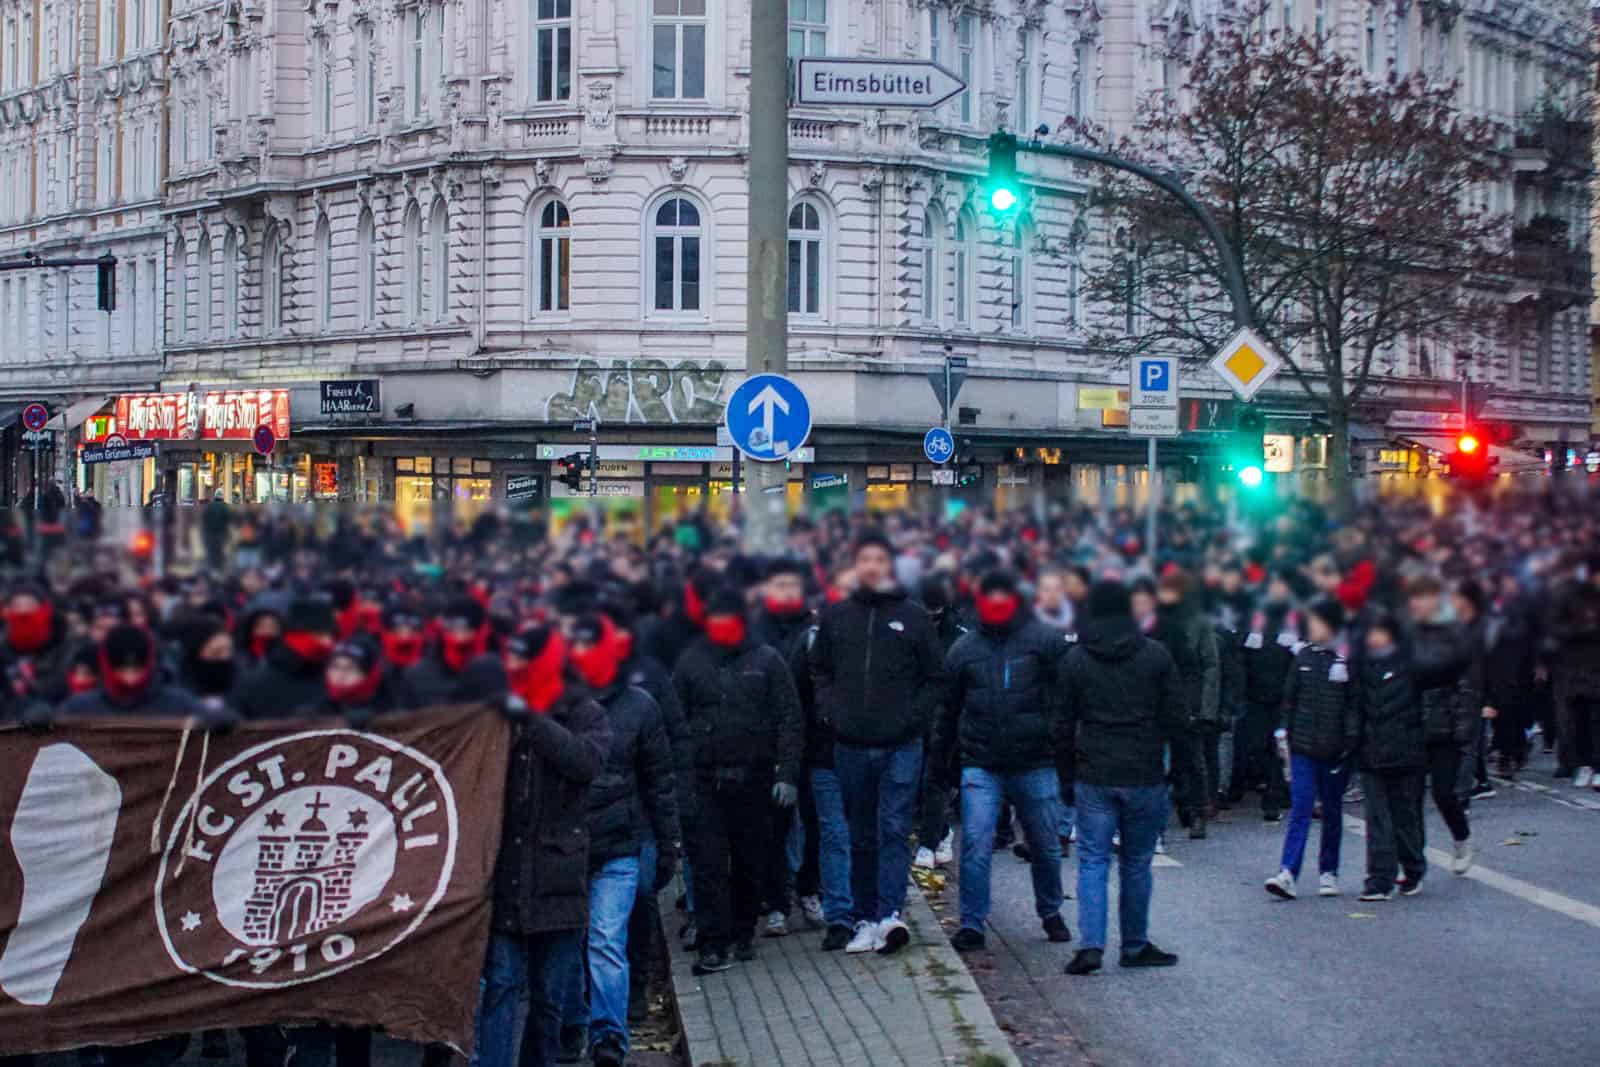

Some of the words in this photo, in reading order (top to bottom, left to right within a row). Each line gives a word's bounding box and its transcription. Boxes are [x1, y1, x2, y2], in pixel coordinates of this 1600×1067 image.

[814, 72, 931, 95] Eimsbüttel
[1146, 365, 1162, 387] P
[324, 743, 440, 850] PAULI
[222, 933, 356, 975] 1910
